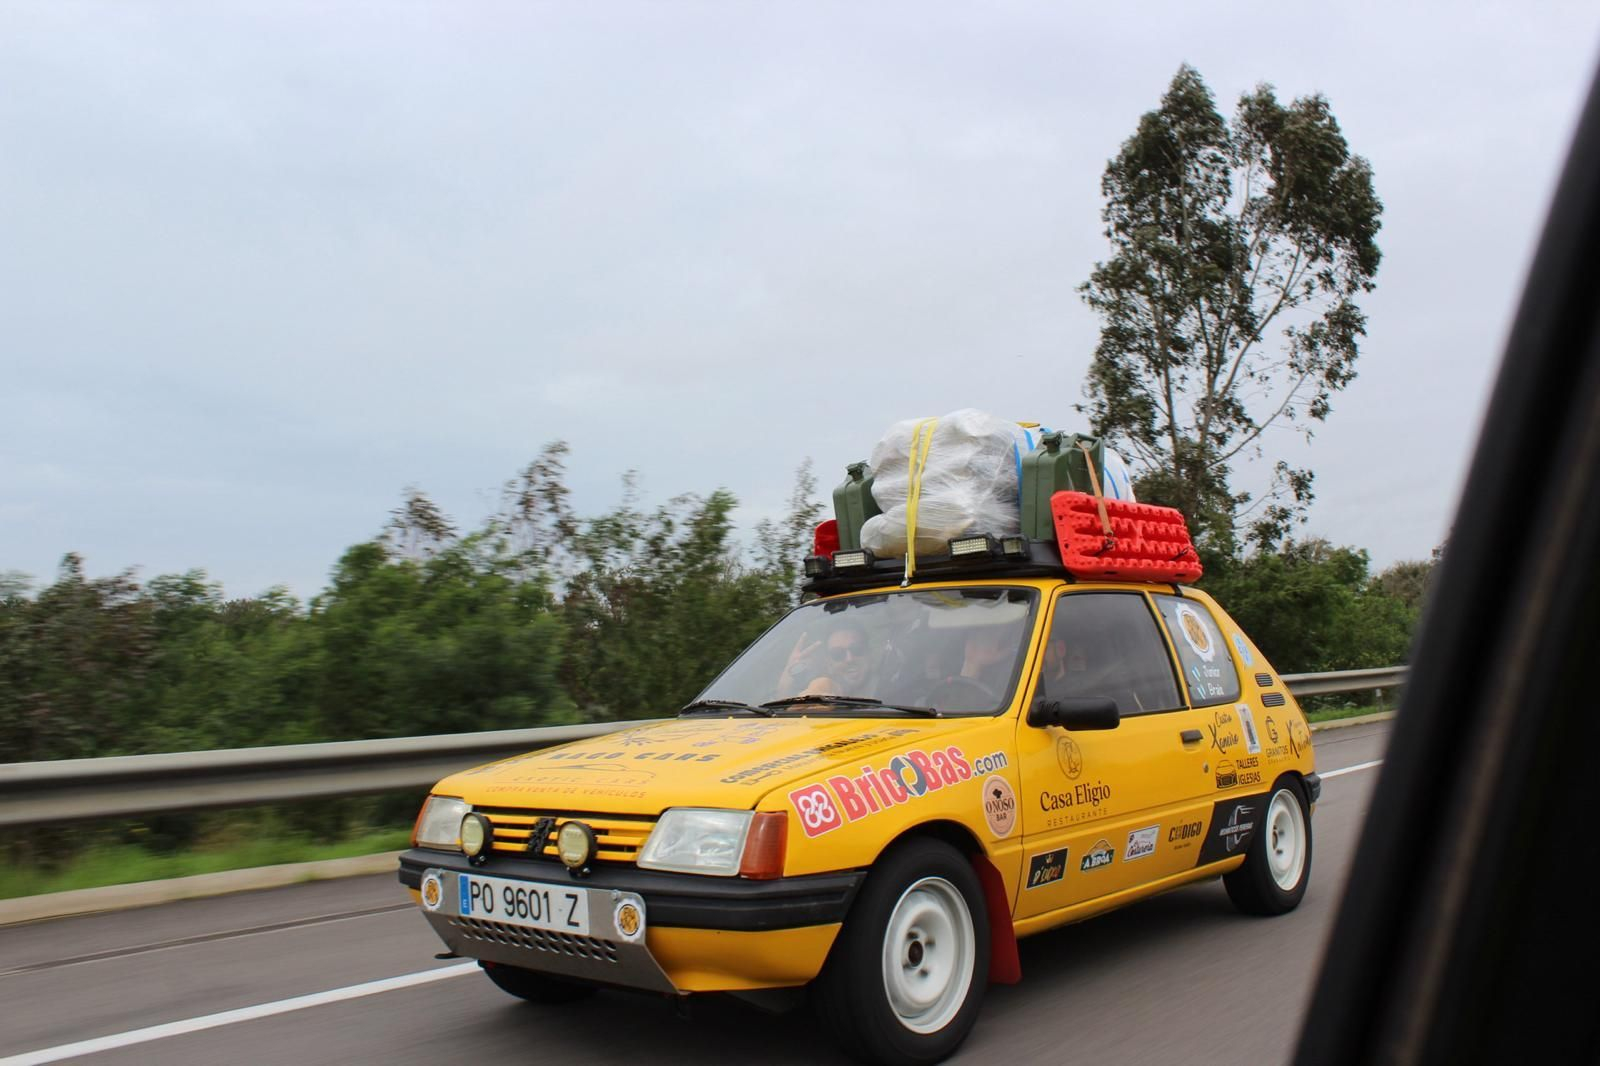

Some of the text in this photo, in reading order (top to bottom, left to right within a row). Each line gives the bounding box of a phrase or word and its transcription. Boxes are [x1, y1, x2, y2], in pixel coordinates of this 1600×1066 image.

[1236, 756, 1259, 770] TALLERES
[1238, 771, 1261, 785] IGLESIAS
[1040, 780, 1111, 811] Casa Eligio
[992, 797, 1015, 813] NOSO
[996, 812, 1008, 822] BAR
[1047, 807, 1109, 827] RESTAURANTE
[471, 880, 580, 927] PO 9601 Z
